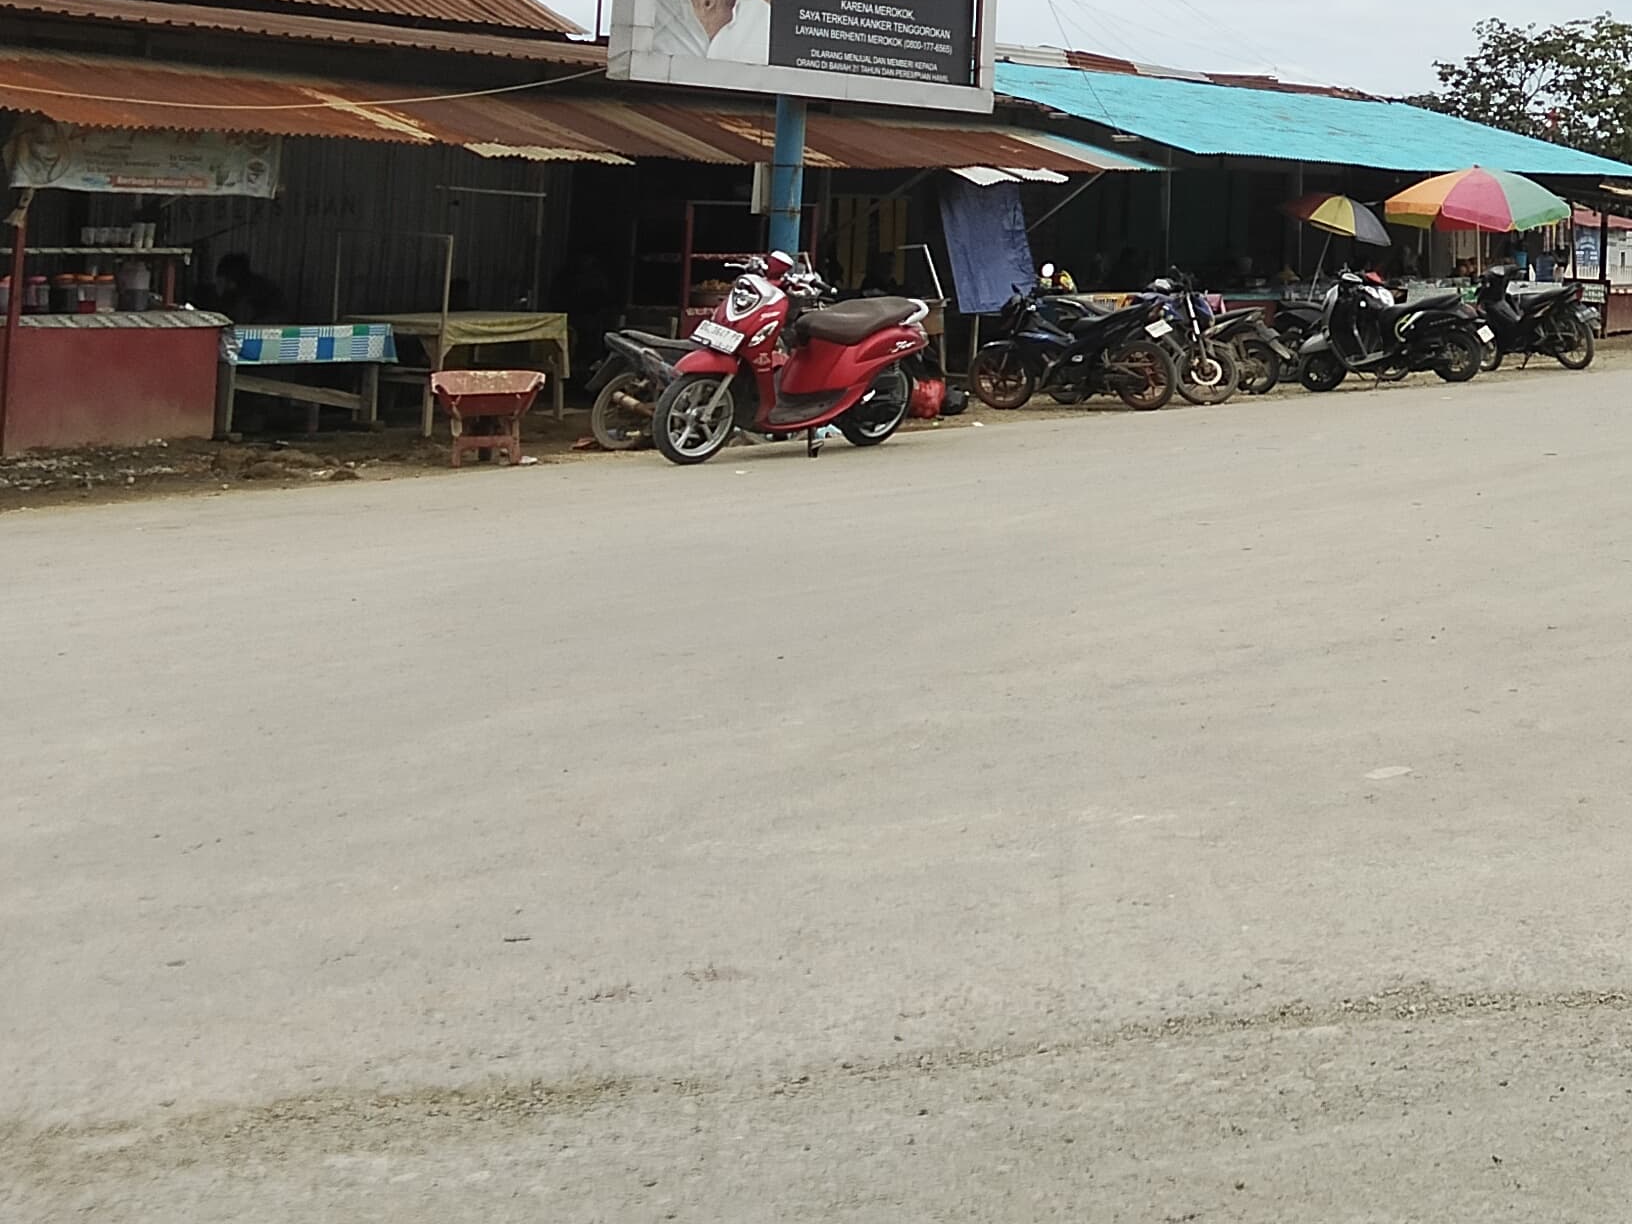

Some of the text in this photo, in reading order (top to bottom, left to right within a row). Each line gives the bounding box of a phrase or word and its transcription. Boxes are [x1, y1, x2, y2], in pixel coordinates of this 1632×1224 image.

[840, 0, 873, 15] KARENA
[799, 8, 952, 40] SAYA TERKENA KANKER TENGGOROKAN
[795, 24, 829, 38] LAYANAN
[830, 28, 867, 43] BERHENTI
[867, 33, 903, 48] MEROKOK
[810, 48, 843, 61] DILARANG
[796, 58, 820, 69] ORANG
